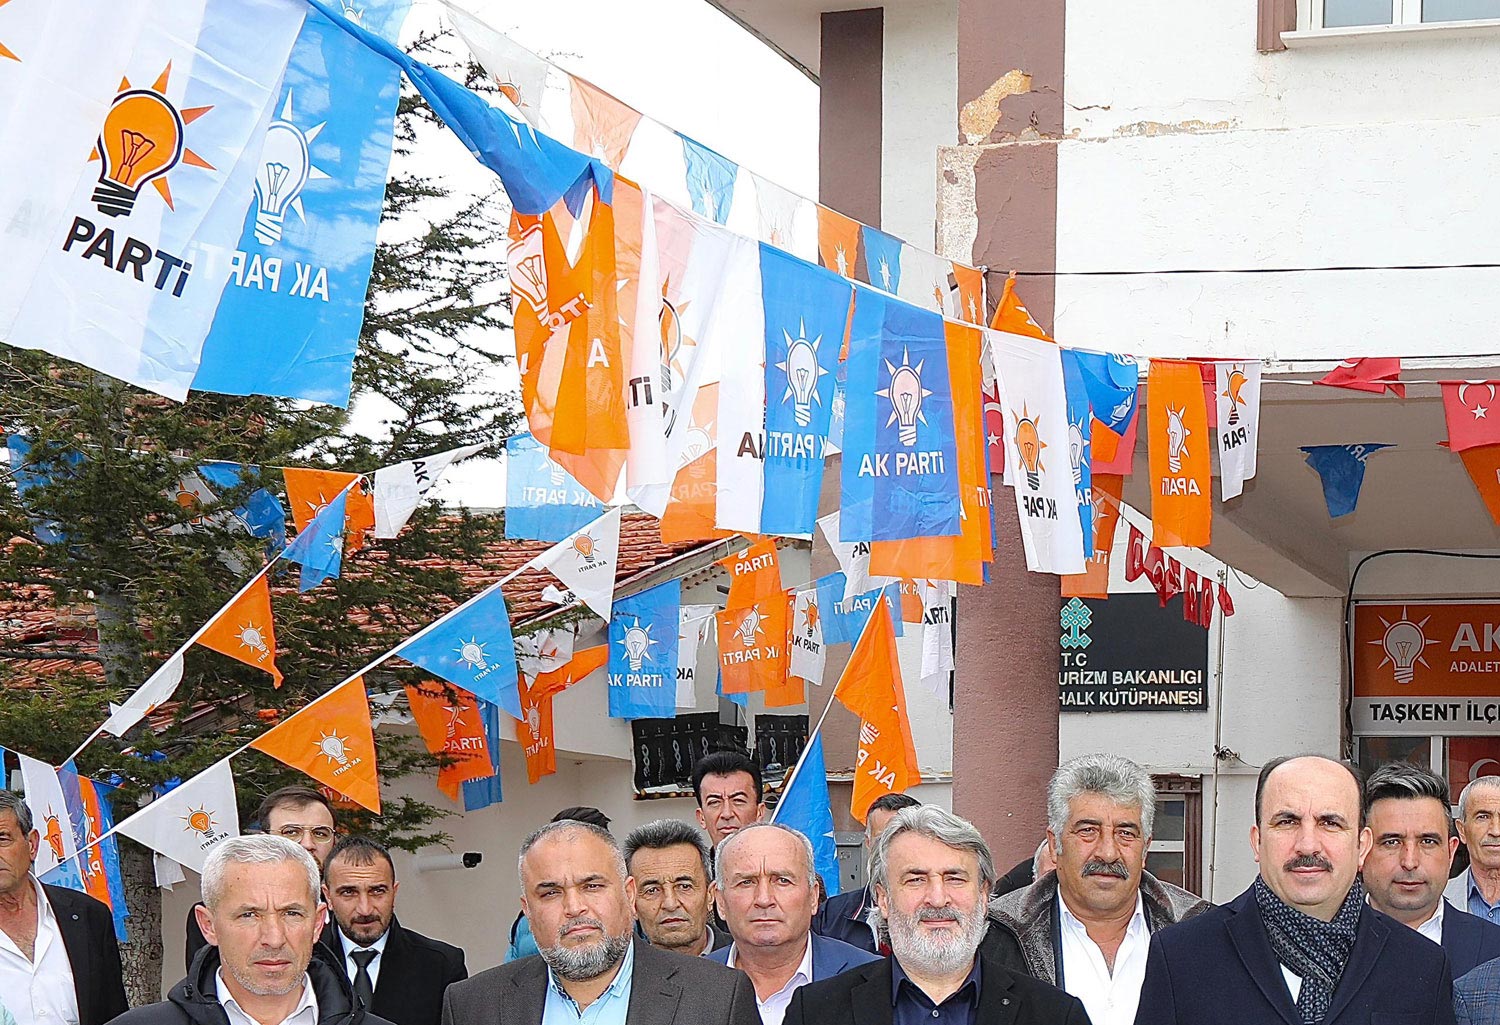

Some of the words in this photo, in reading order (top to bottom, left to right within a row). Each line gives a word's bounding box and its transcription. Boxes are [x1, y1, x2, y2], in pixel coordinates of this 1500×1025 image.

[858, 453, 890, 477] AK
[1450, 661, 1500, 673] ADALET
[1369, 703, 1461, 727] TAŞKENT
